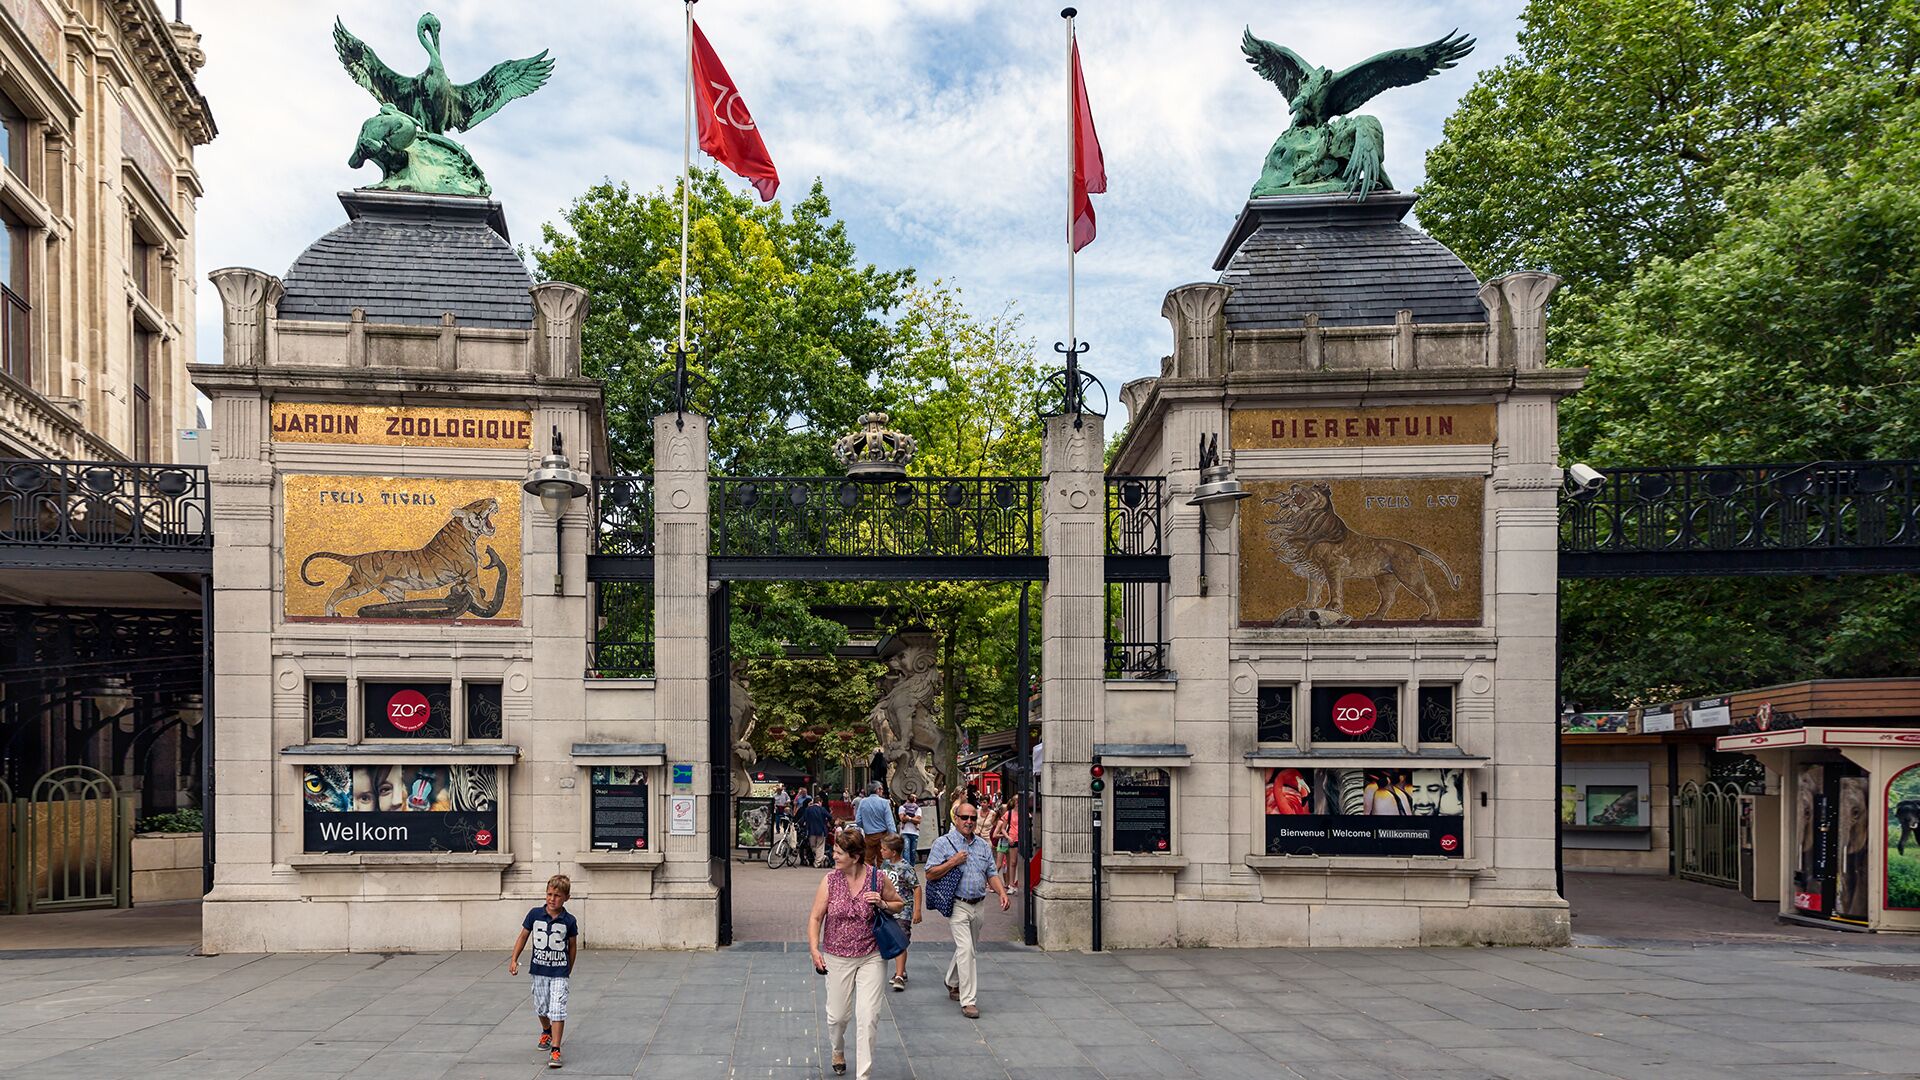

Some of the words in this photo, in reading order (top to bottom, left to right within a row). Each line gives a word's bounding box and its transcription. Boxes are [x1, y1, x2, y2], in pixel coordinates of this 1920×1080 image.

[274, 413, 358, 435] JARDIN
[386, 416, 530, 441] ZOOLOGIQUE
[1271, 415, 1454, 439] DIERENTUIN
[320, 490, 364, 506] FELIS
[381, 490, 436, 506] TIGRIS
[1365, 495, 1411, 510] FELIS
[1426, 494, 1459, 508] LEO
[319, 822, 408, 841] Welkom
[1280, 828, 1325, 838] Bienvenue
[1332, 828, 1372, 838] Welcome
[1378, 829, 1429, 840] Willkommen
[532, 920, 568, 952] 62
[533, 948, 567, 961] PREMIUM
